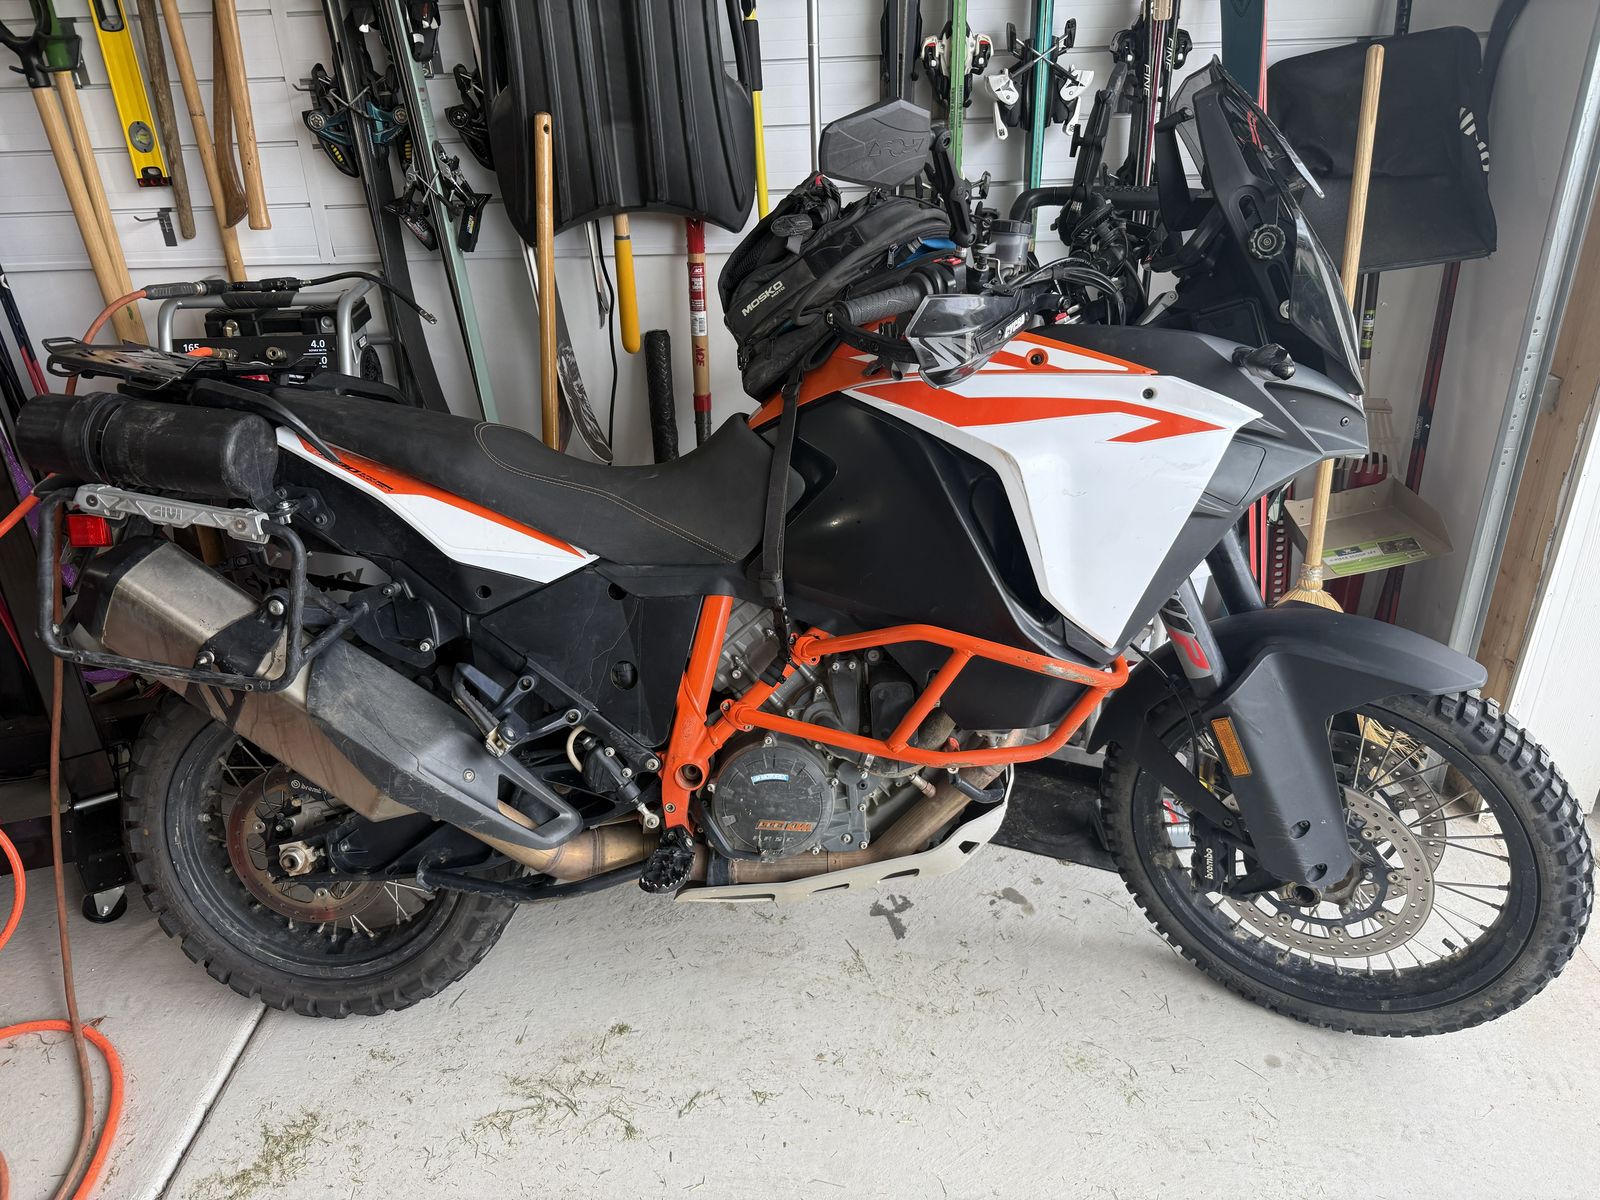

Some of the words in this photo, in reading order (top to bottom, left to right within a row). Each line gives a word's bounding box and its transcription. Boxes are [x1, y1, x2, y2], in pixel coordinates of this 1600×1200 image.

[741, 280, 783, 317] MOSKO
[183, 343, 200, 352] 165
[311, 339, 326, 348] 4.0
[695, 344, 705, 368] ACE
[1204, 847, 1214, 880] brembo
